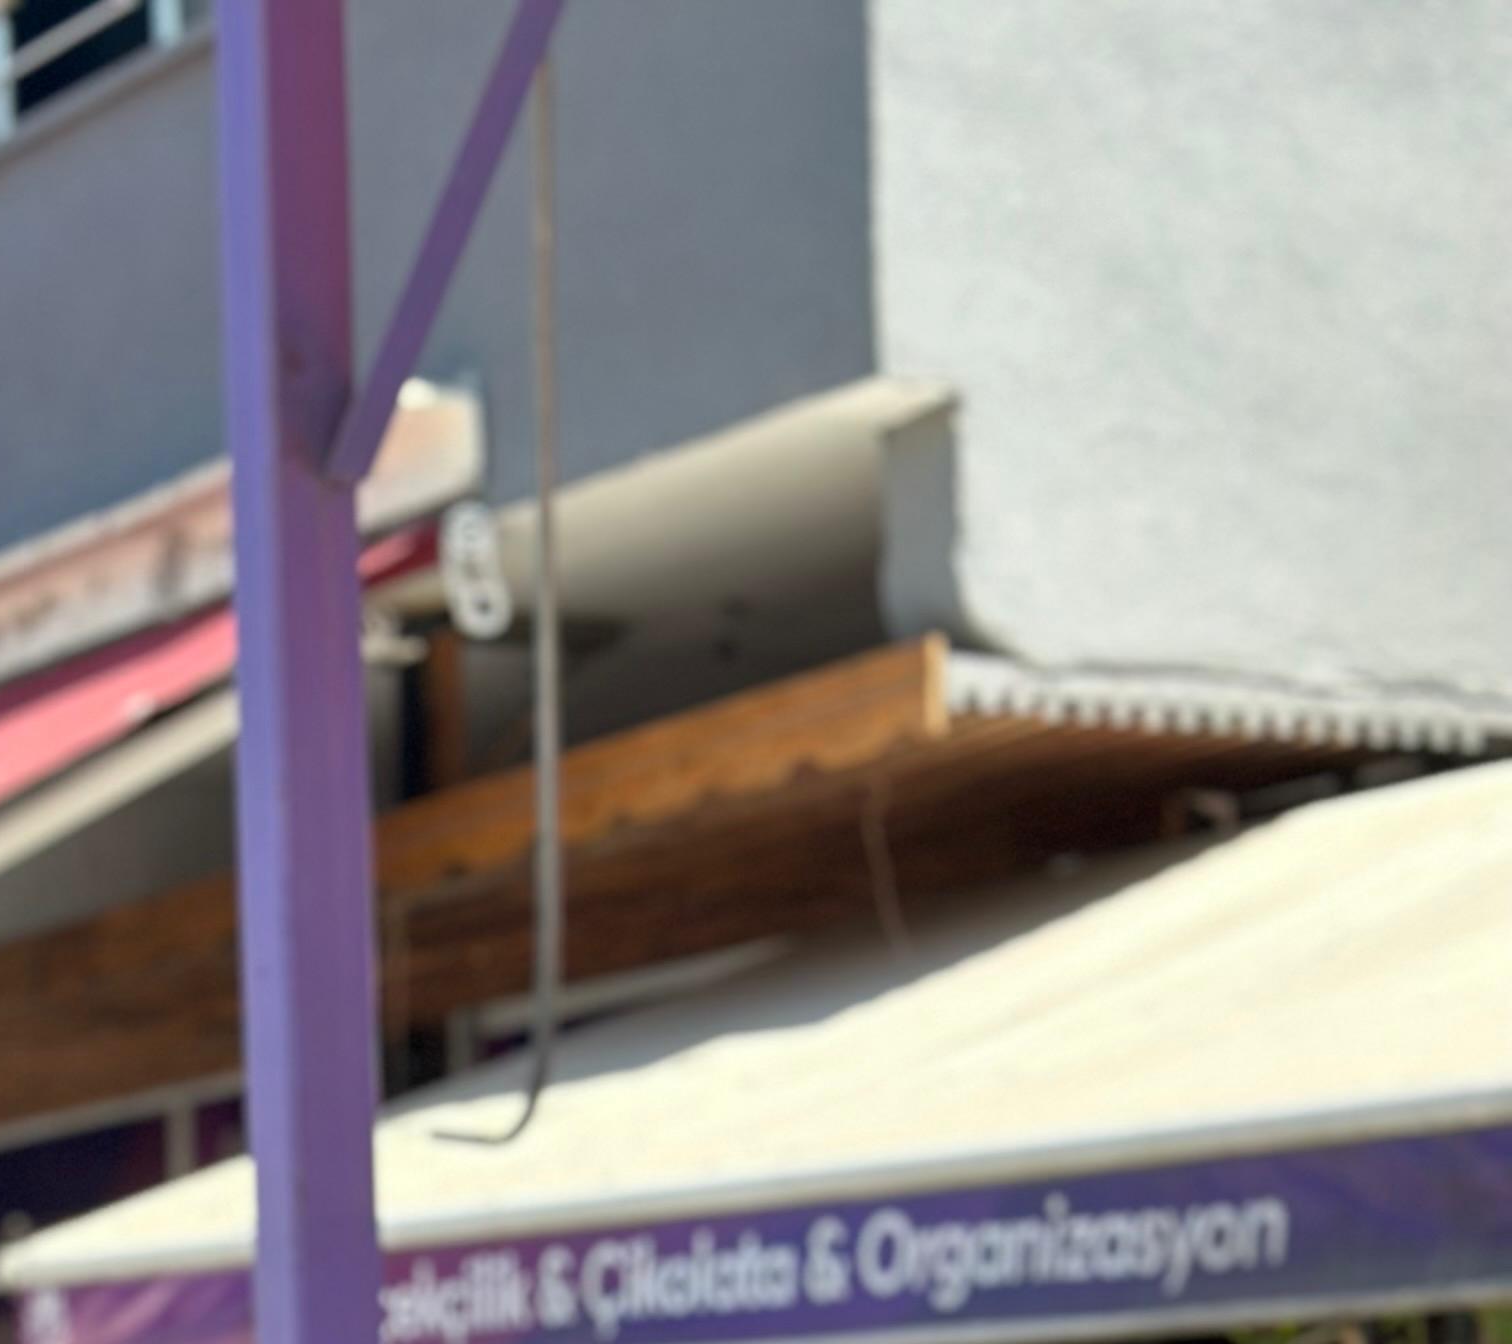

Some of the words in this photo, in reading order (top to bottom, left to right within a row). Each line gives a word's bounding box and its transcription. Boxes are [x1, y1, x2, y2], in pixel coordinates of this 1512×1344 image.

[536, 1242, 576, 1330] &
[581, 1226, 799, 1343] Çikolata
[803, 1215, 849, 1304] &
[856, 1191, 1290, 1312] Organizasyon
